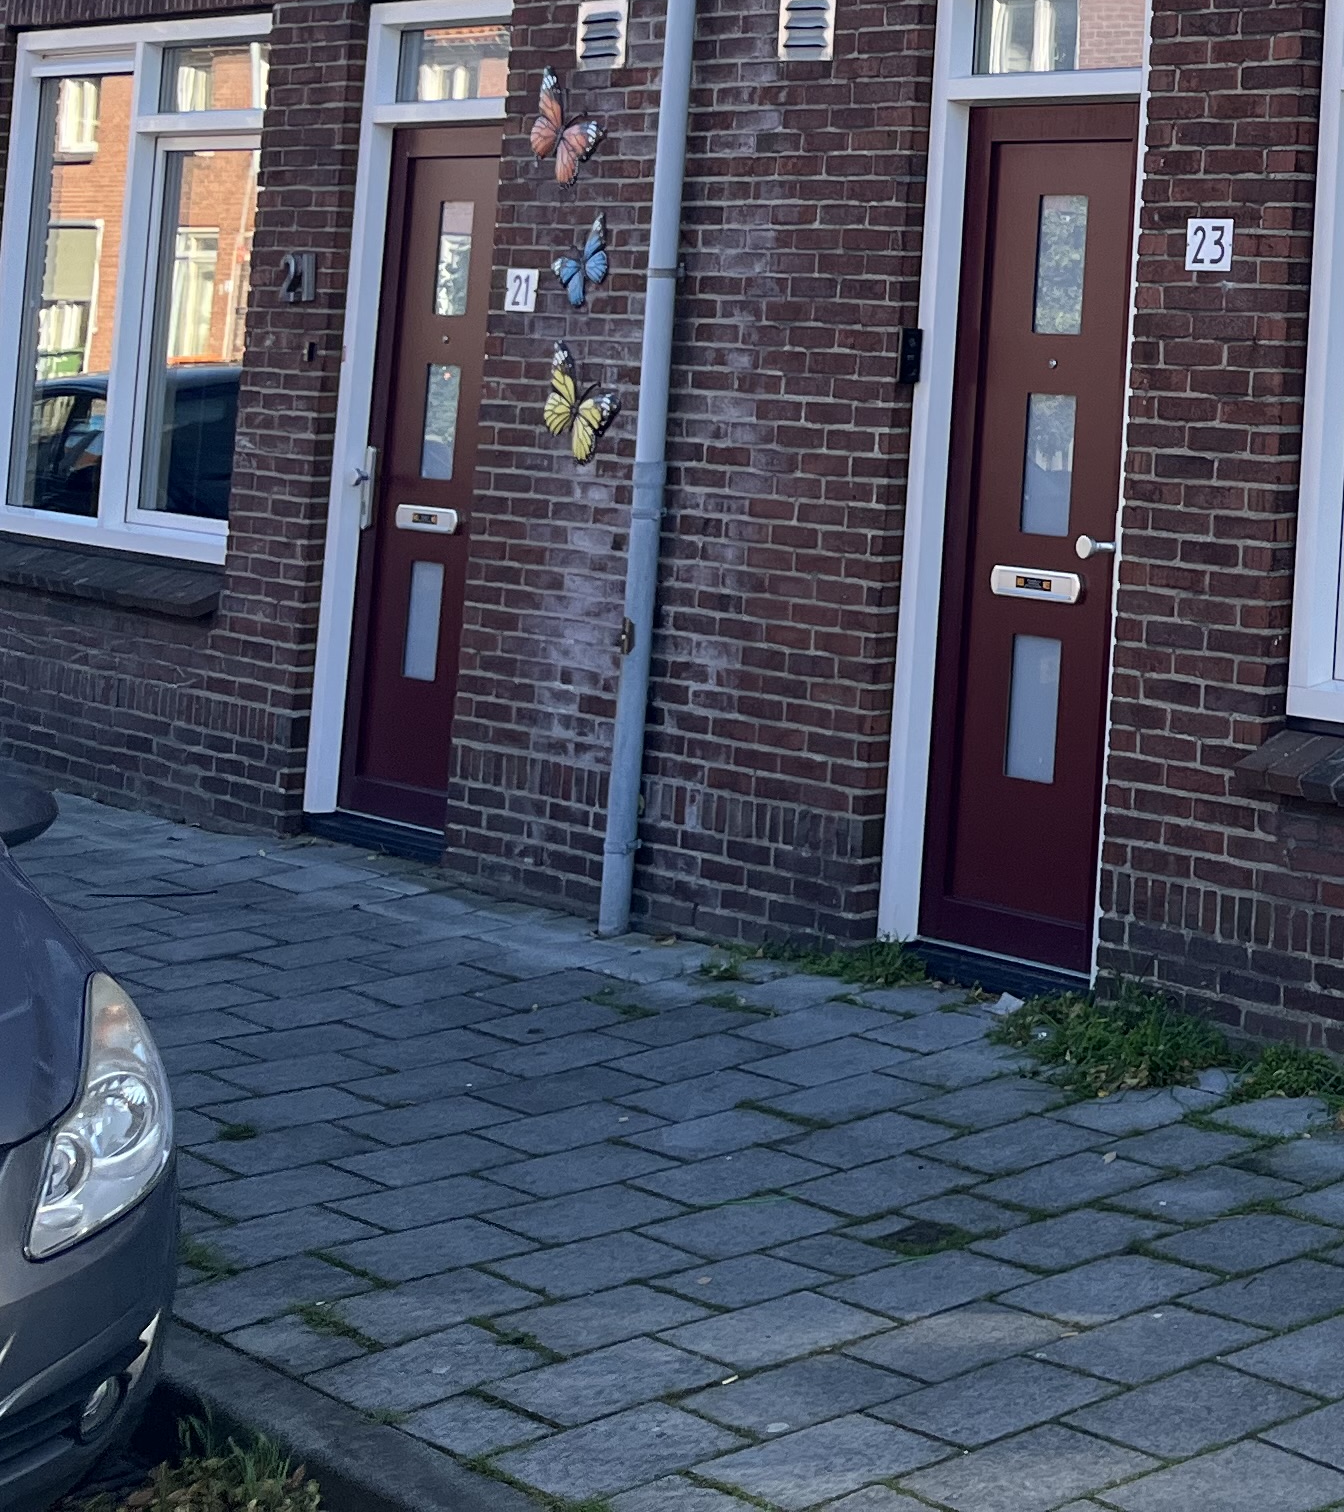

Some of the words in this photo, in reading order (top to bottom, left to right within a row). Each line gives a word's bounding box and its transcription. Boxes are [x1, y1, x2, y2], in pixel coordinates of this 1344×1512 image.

[1191, 225, 1225, 264] 23
[278, 253, 316, 303] 21
[511, 274, 530, 306] 21
